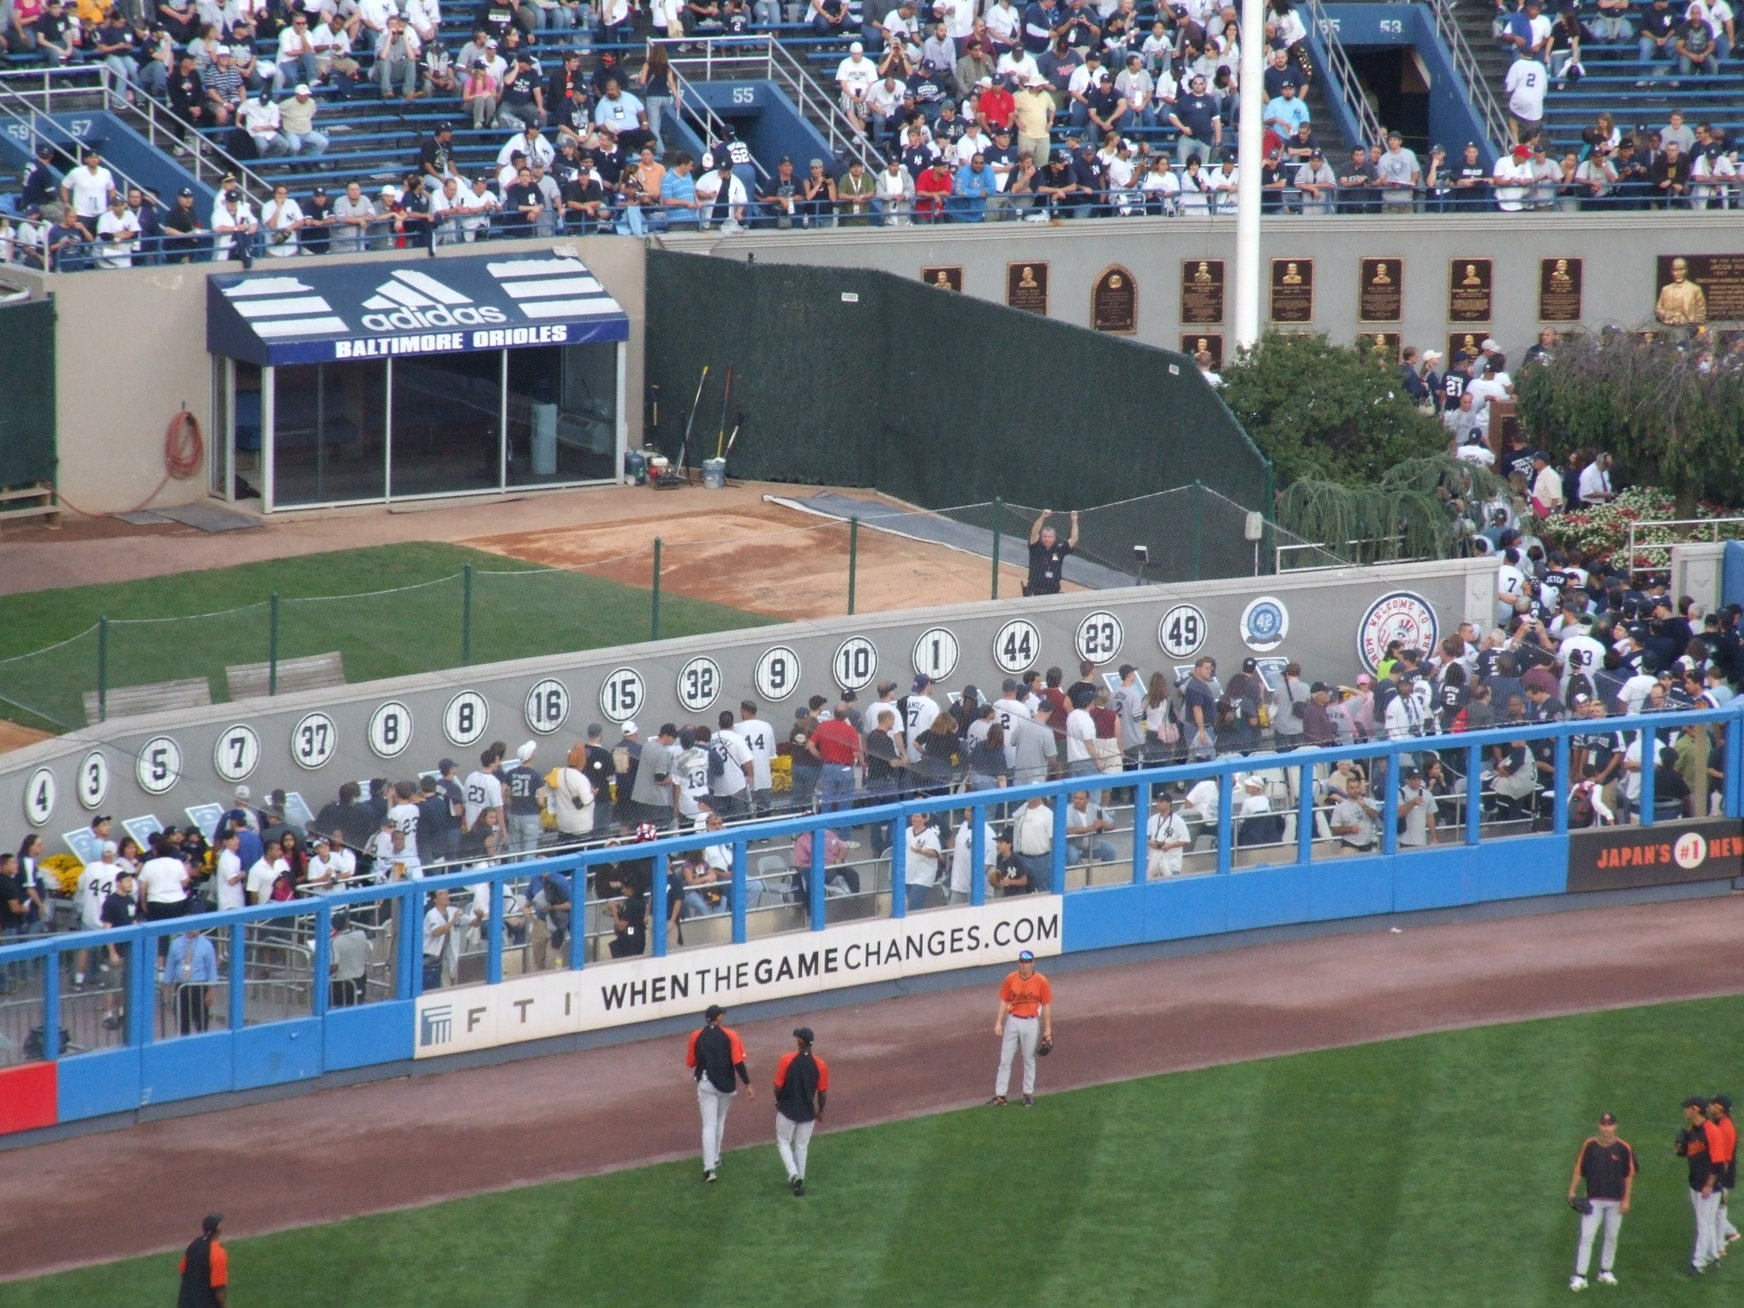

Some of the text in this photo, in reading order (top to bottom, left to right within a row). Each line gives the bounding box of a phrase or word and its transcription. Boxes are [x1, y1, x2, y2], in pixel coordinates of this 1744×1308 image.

[733, 87, 754, 103] 55
[1526, 73, 1536, 88] 2
[7, 124, 30, 140] 59
[71, 120, 92, 136] 57
[361, 305, 507, 331] adidas
[335, 325, 568, 358] BALTIMORE ORIOLES
[1446, 381, 1463, 396] 21
[1508, 576, 1517, 592] 7
[1255, 613, 1273, 630] 42
[1370, 600, 1429, 627] WELCOME TO
[1004, 630, 1031, 661] 44
[1085, 622, 1114, 654] 23
[1168, 615, 1198, 647] 49
[843, 647, 869, 680] 10
[932, 640, 940, 670] 1
[687, 667, 713, 700] 32
[770, 658, 785, 689] 9
[535, 690, 561, 723] 16
[610, 678, 636, 711] 15
[1446, 693, 1458, 706] 2
[384, 714, 398, 745] 8
[458, 702, 474, 733] 8
[909, 710, 919, 727] 7
[1001, 713, 1010, 730] 2
[230, 737, 246, 769] 7
[301, 723, 328, 757] 37
[88, 764, 99, 795] 3
[152, 748, 167, 781] 5
[468, 785, 485, 803] 23
[511, 779, 530, 797] 21
[688, 771, 704, 789] 13
[36, 780, 47, 811] 4
[1597, 844, 1671, 869] JAPAN'S
[1680, 839, 1699, 860] #1
[89, 879, 112, 896] 44
